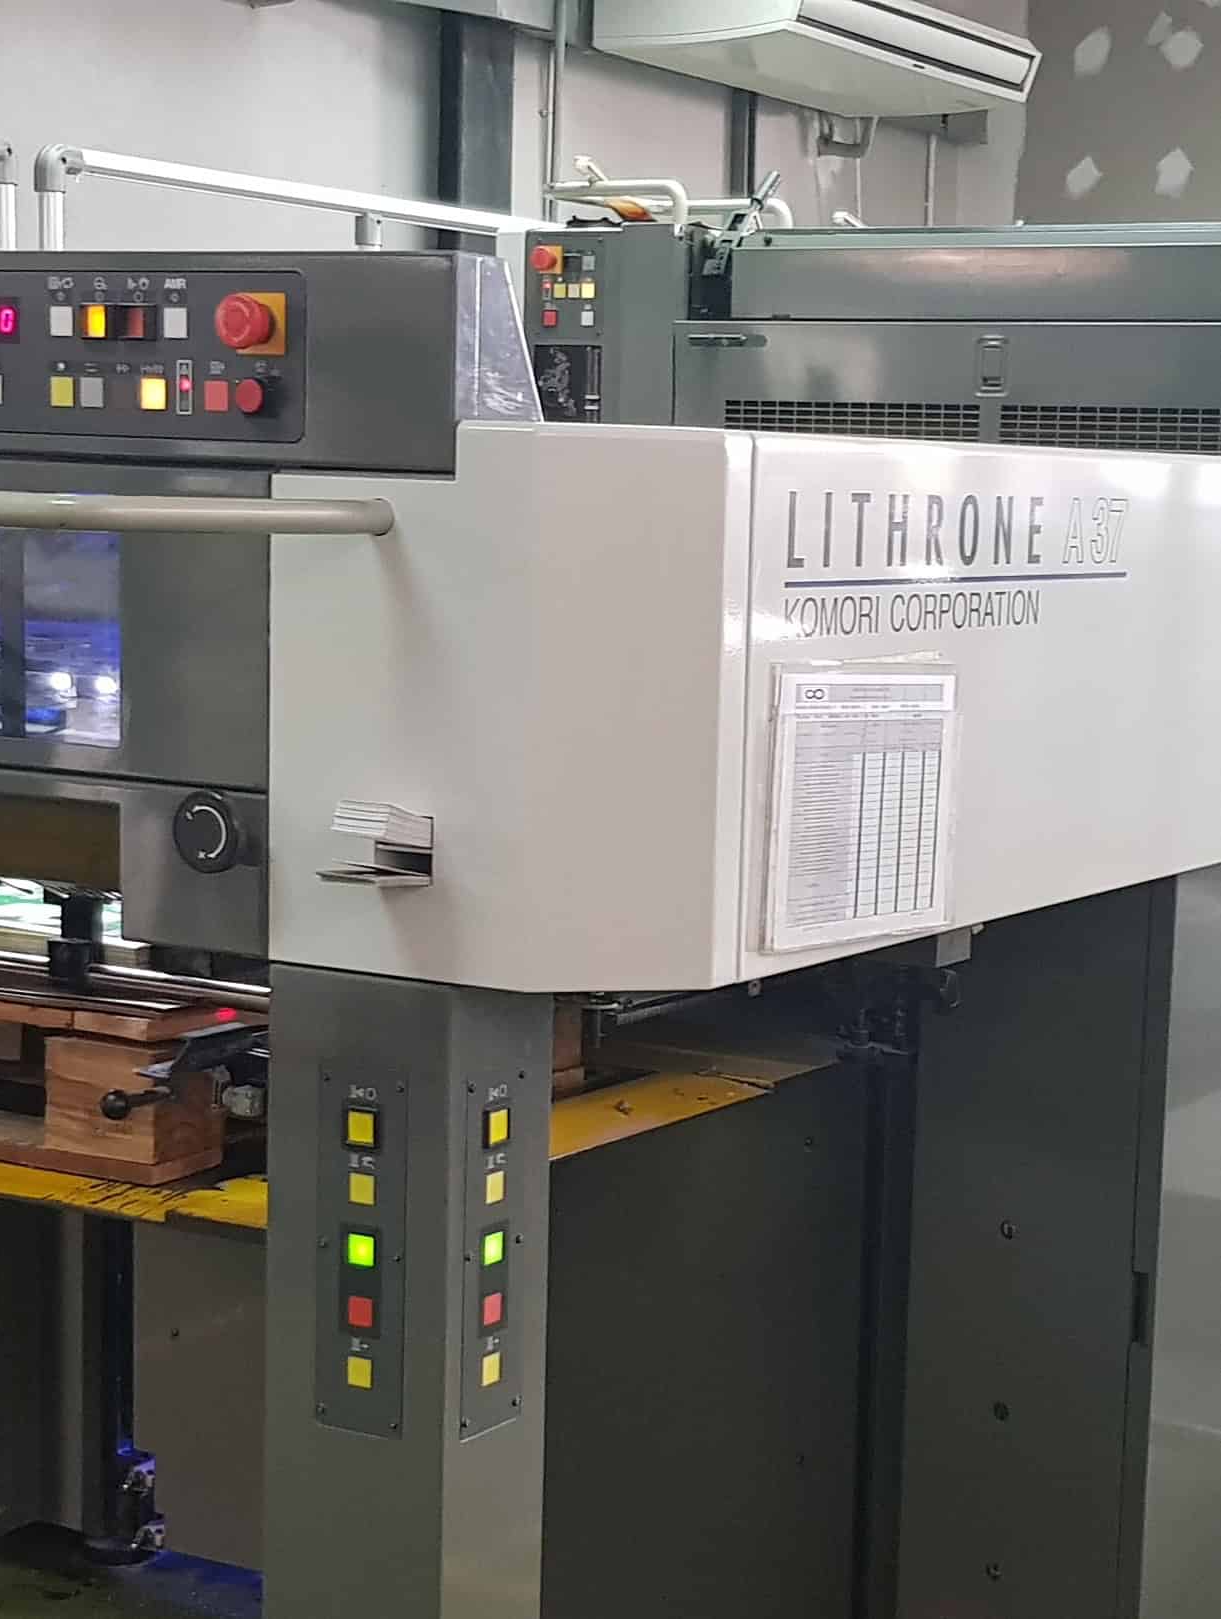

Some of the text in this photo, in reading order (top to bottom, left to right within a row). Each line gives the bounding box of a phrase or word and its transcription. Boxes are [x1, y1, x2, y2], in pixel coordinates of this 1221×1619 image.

[786, 490, 1129, 569] LITHRONE A37
[783, 589, 1040, 640] KOMORI CORPORATION
